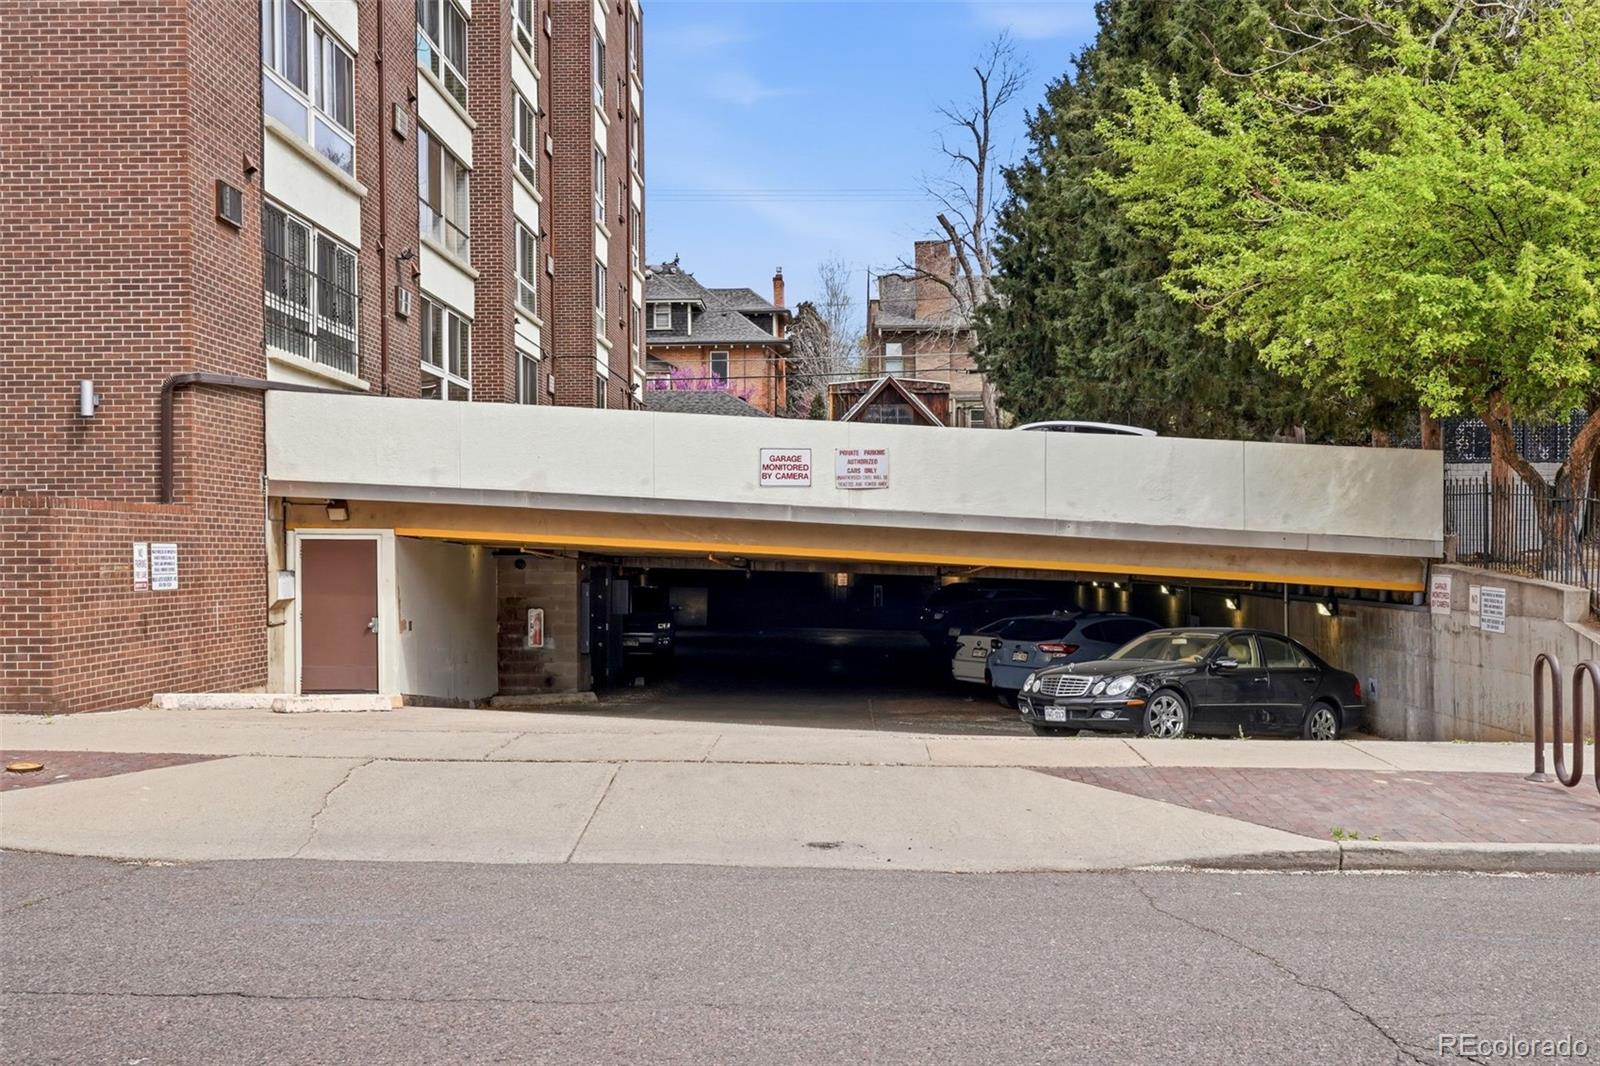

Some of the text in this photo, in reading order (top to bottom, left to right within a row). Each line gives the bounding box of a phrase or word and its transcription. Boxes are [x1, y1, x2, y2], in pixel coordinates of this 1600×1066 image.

[762, 463, 809, 471] MONITORED
[761, 472, 809, 480] BY CAMERA
